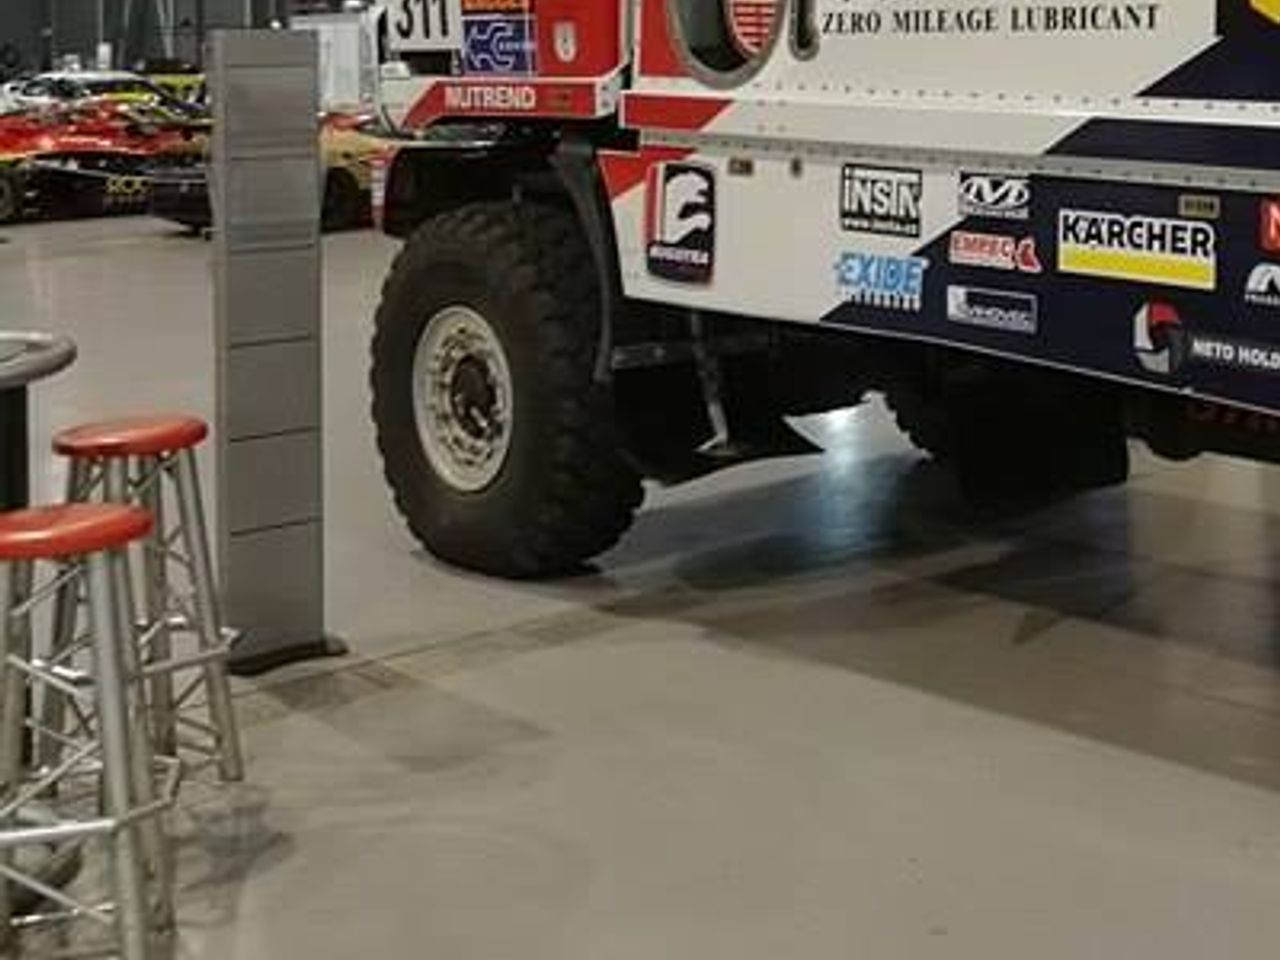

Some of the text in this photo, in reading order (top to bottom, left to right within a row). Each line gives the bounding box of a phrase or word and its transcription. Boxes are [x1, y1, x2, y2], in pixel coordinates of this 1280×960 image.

[821, 3, 1159, 36] ZERO MILEAGE LUBRICANT
[444, 85, 537, 110] NUTREND
[1062, 213, 1212, 258] KÄRCHER
